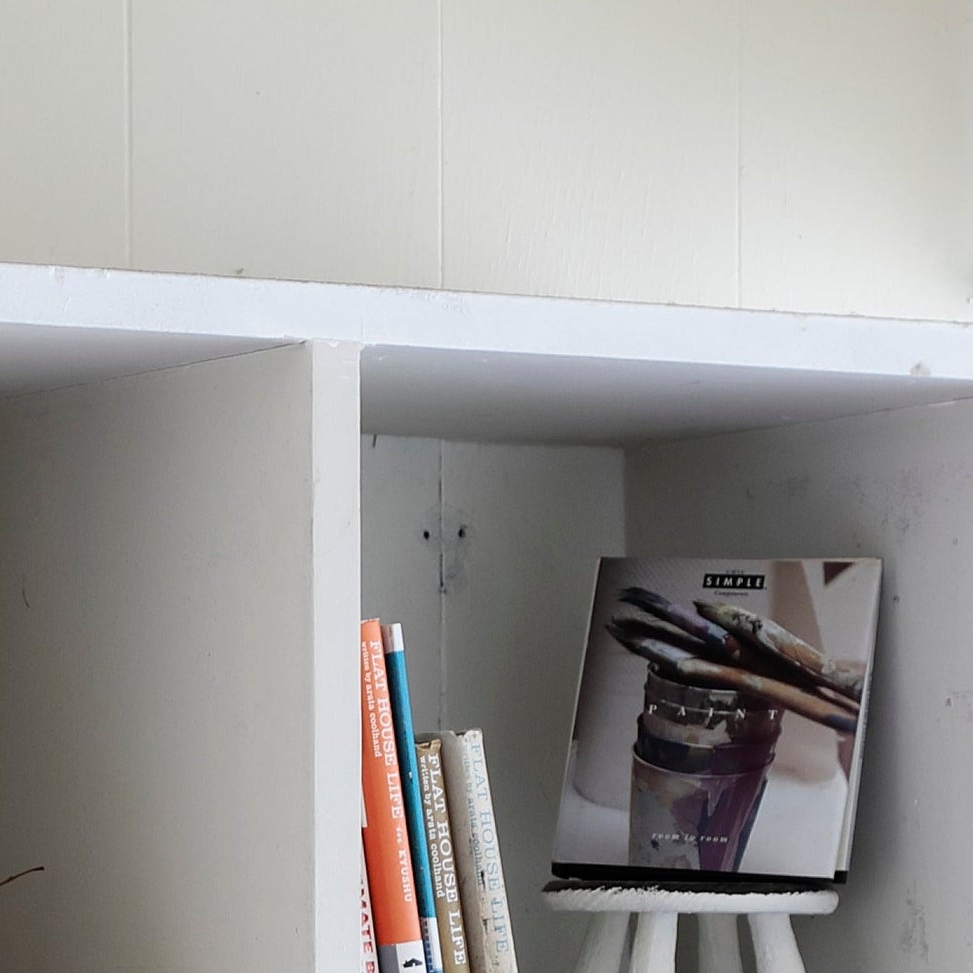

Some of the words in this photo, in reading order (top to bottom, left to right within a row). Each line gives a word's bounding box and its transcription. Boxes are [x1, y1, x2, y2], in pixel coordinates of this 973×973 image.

[706, 576, 763, 587] SIMPLE
[364, 672, 371, 682] by
[370, 640, 387, 691] FLAT
[366, 684, 375, 712] arata
[648, 704, 778, 720] PAINT
[370, 713, 383, 758] coolhand
[377, 697, 398, 767] HOUSE
[387, 772, 404, 819] LIFE
[420, 755, 430, 792] written
[428, 753, 447, 814] FLAT
[423, 793, 432, 808] by
[426, 809, 437, 842] arata
[471, 743, 488, 801] FLAT
[480, 811, 501, 892] HOUSE
[491, 897, 509, 953] LIFE
[651, 832, 680, 842] room
[700, 833, 728, 843] room
[398, 850, 413, 903] KYUSHU
[431, 843, 445, 899] coolhand
[437, 821, 459, 903] HOUSE
[448, 909, 467, 966] LIFE
